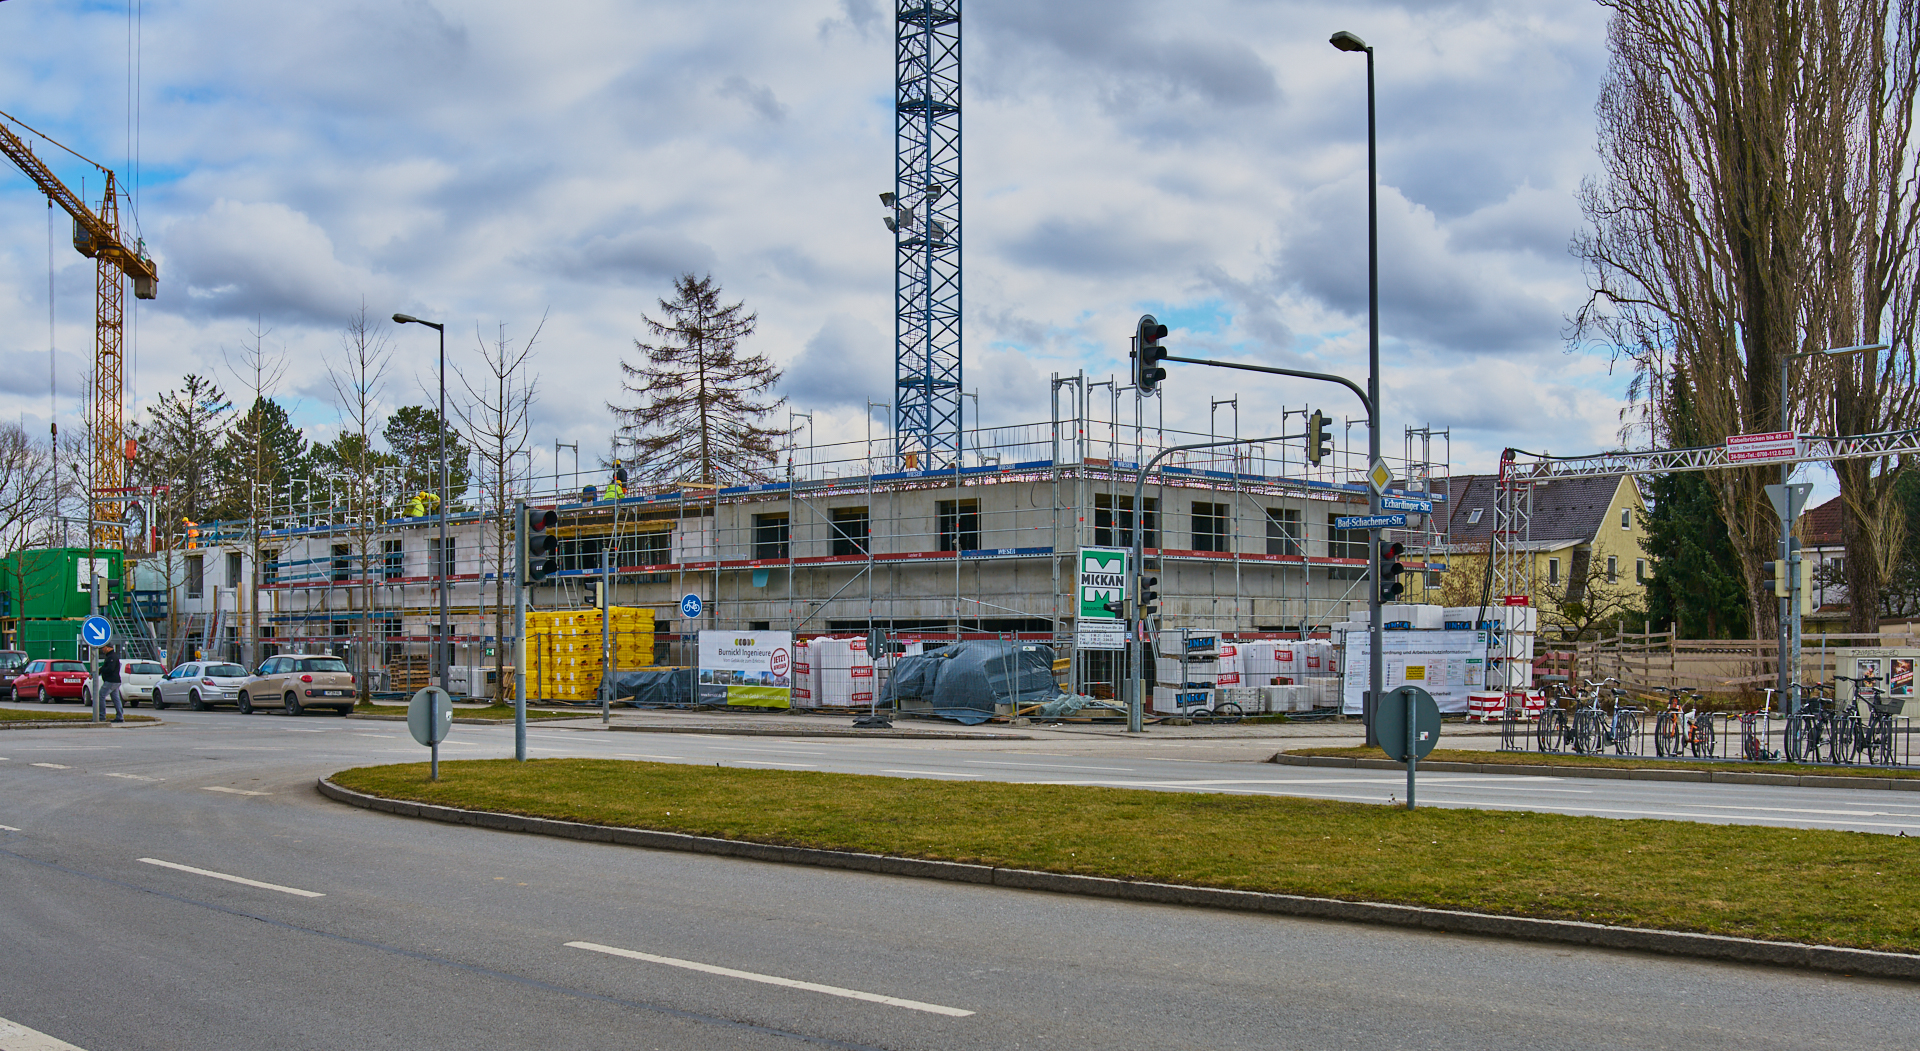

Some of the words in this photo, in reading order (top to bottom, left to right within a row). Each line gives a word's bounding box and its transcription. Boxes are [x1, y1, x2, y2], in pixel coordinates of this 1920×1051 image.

[1730, 436, 1765, 444] Kabelbrücken
[1384, 499, 1419, 511] Echardinger
[1420, 502, 1431, 511] Str.
[1337, 516, 1404, 528] Bad-Schachener-Str.
[1081, 573, 1124, 587] MICKAN
[718, 648, 741, 656] Burnickl
[742, 649, 771, 658] Ingenieure
[773, 654, 786, 664] JETZT
